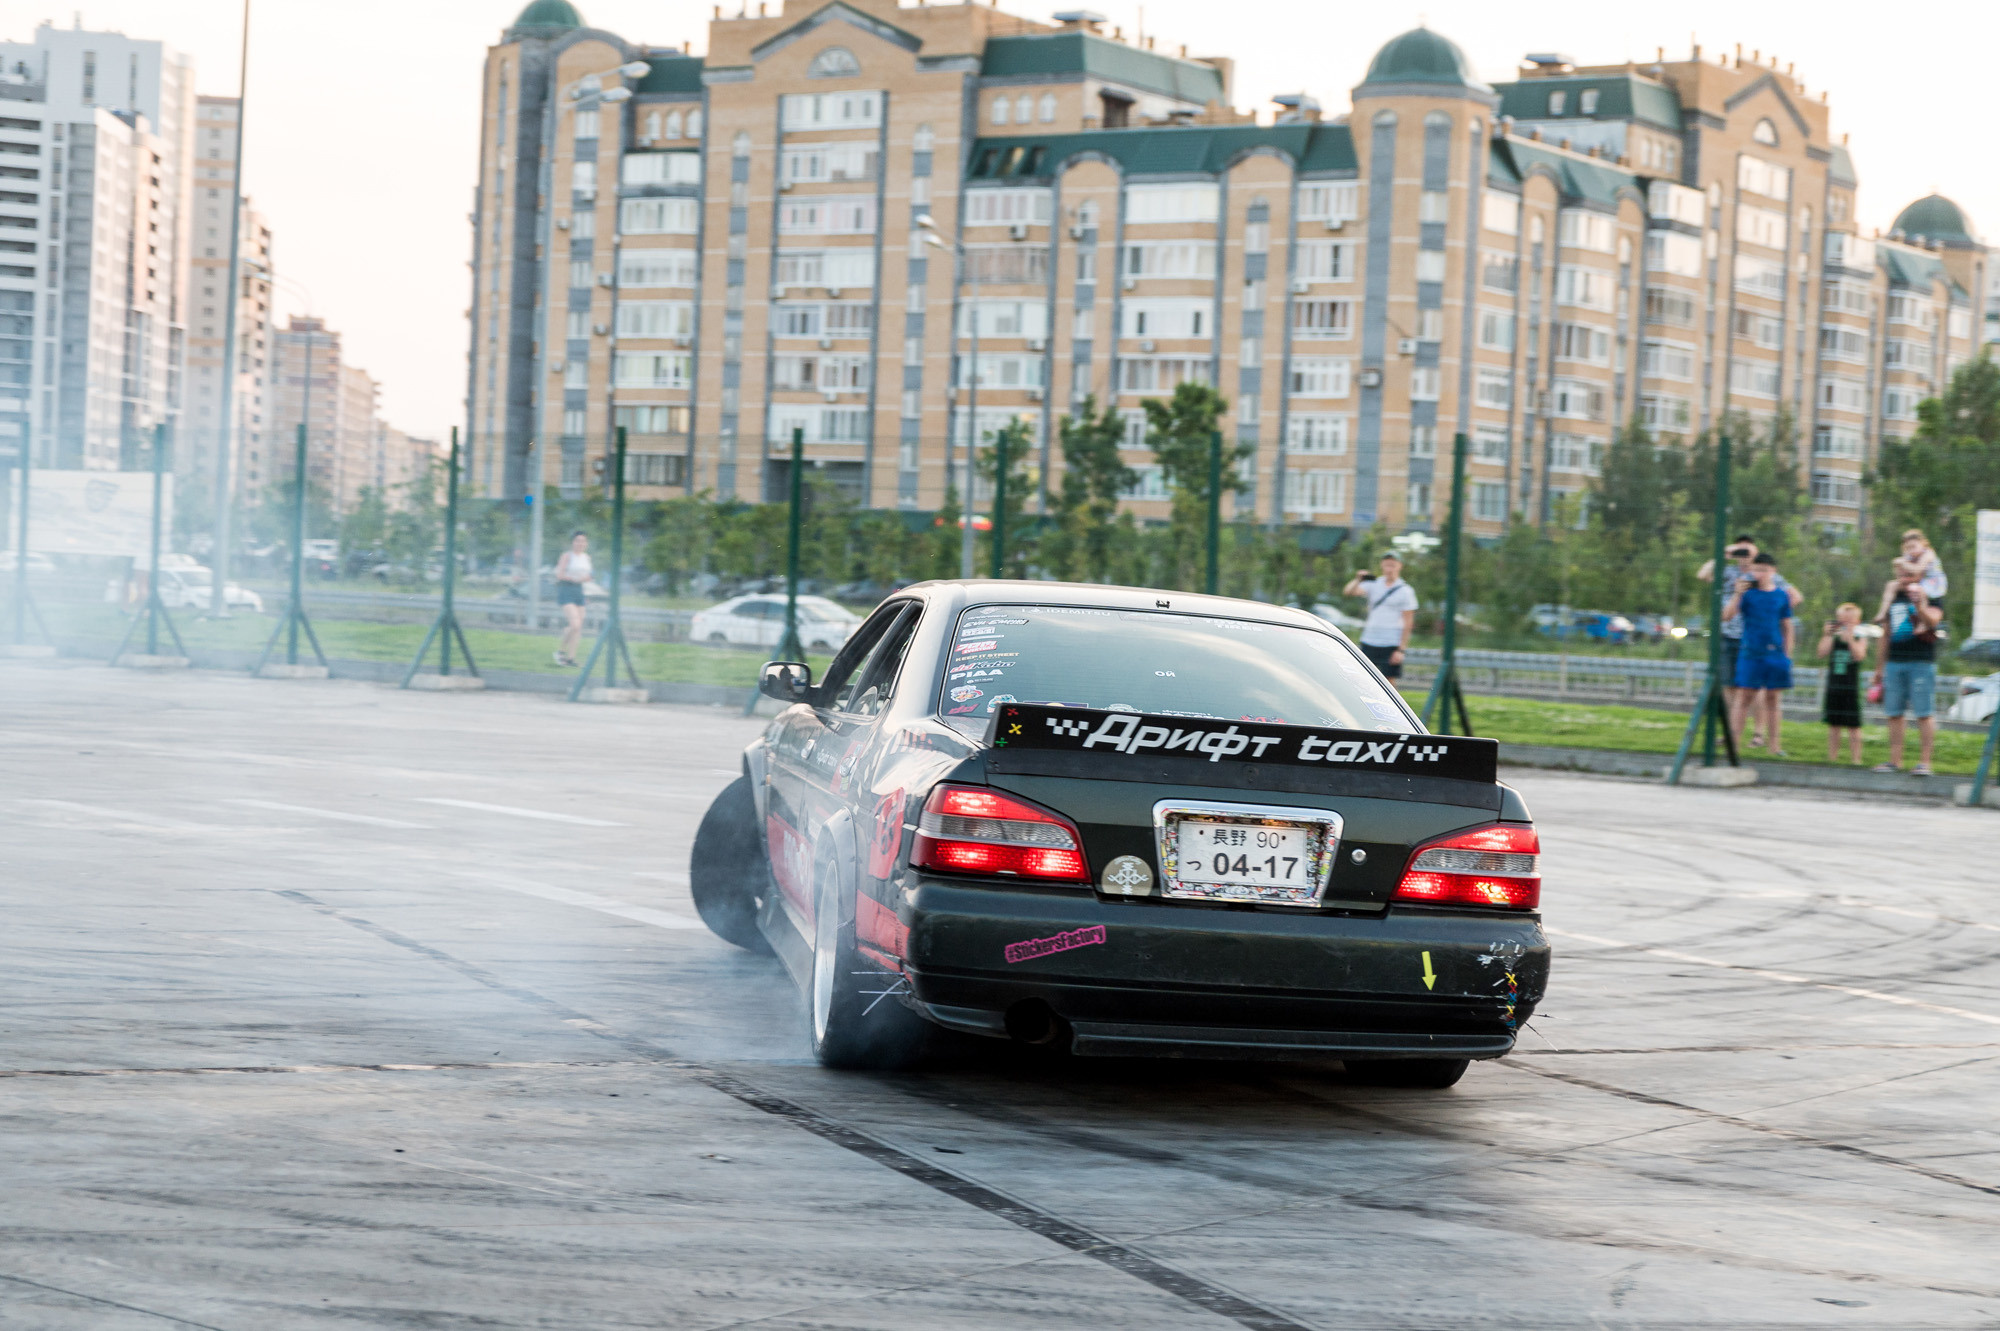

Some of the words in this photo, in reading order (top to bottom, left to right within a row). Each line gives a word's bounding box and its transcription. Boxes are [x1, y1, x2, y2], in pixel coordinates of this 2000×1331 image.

[1046, 608, 1111, 617] IDEMITSU
[951, 669, 1003, 680] PIAA
[1083, 714, 1282, 762] Дрифт
[1298, 734, 1411, 764] taxi
[1213, 828, 1247, 847] 長野
[1256, 831, 1280, 849] 90
[1186, 860, 1202, 871] つ
[1213, 852, 1299, 880] 04-17
[1006, 926, 1105, 961] #StickersFactory
